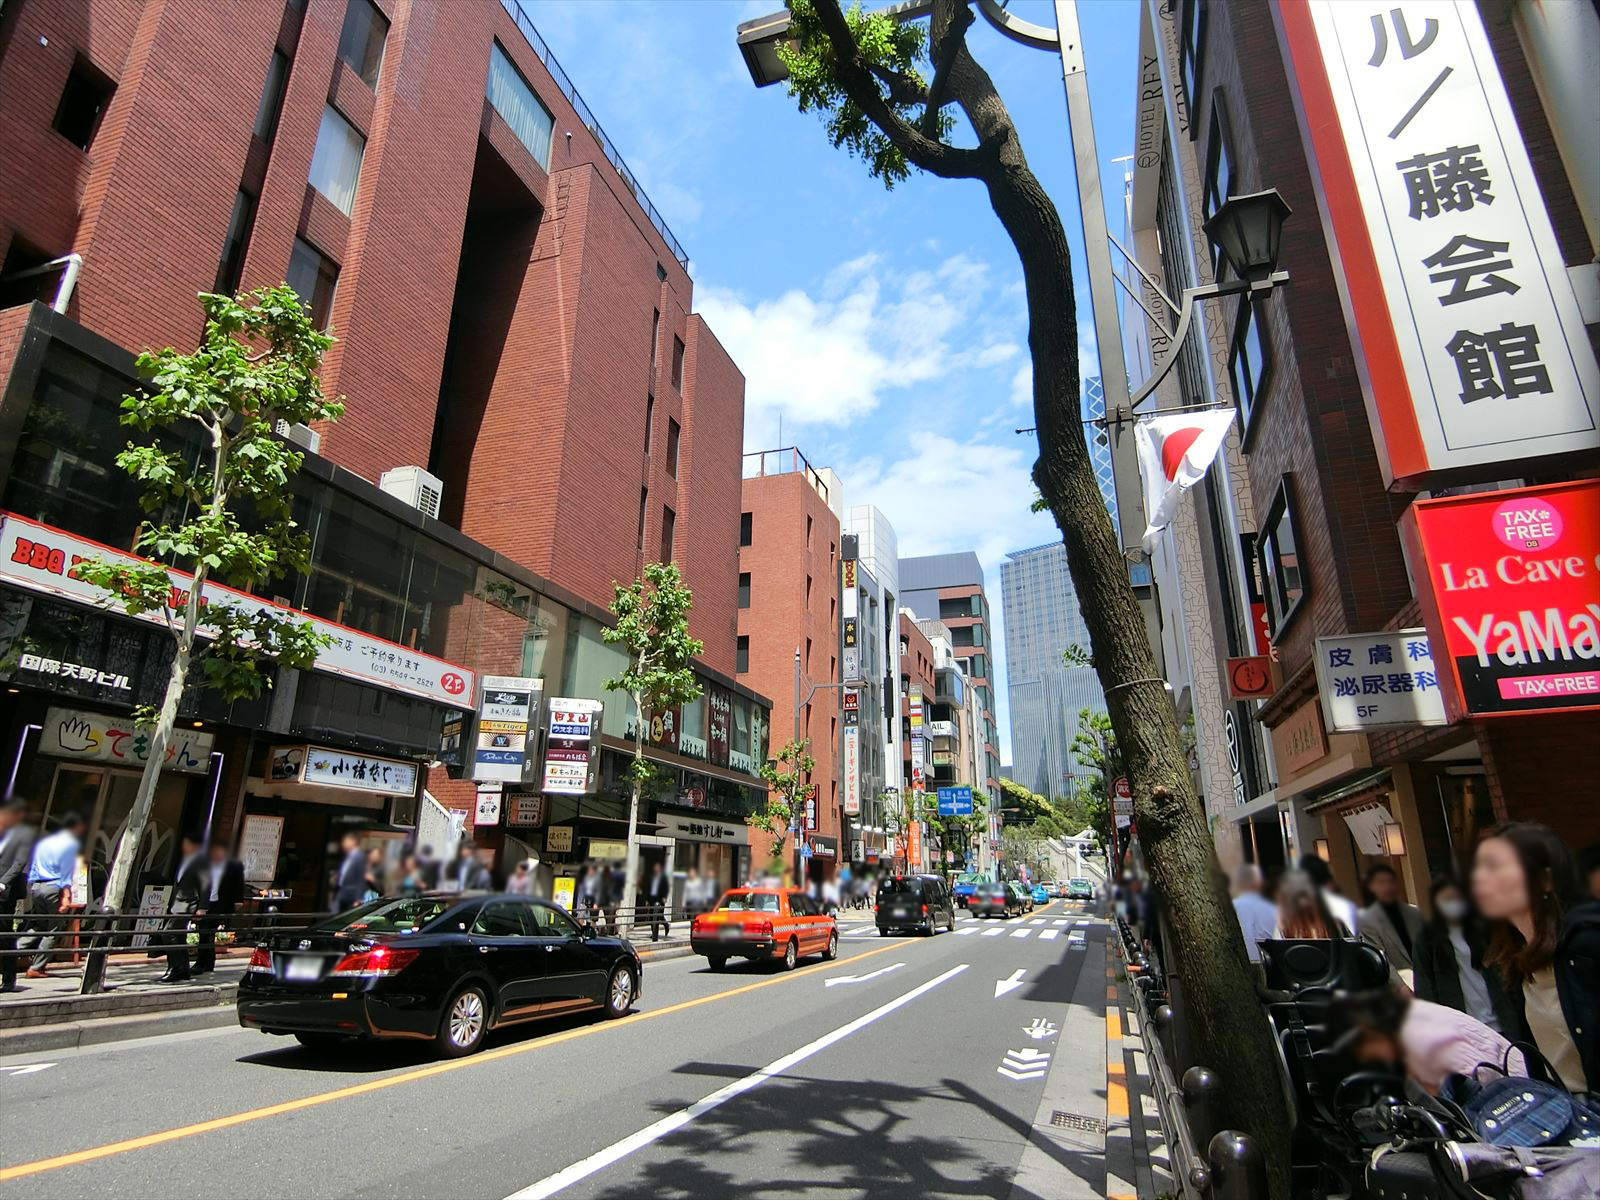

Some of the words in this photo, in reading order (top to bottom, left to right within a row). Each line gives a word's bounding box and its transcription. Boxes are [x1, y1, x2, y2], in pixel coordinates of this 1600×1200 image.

[1140, 103, 1156, 151] HOTEL
[1151, 334, 1170, 367] RE
[1500, 509, 1540, 526] TAX
[1504, 522, 1555, 541] FREE
[11, 536, 66, 575] BBQ
[1440, 562, 1489, 592] La
[1495, 555, 1585, 585] Cave
[1329, 640, 1433, 668] 皮膚科
[20, 653, 132, 691] 国際天野ビル
[444, 674, 462, 692] 2F
[1334, 669, 1441, 698] 泌尿器科
[1513, 679, 1548, 695] TAX
[1553, 676, 1599, 692] FREE
[554, 711, 589, 723] 阿里山
[1356, 705, 1379, 718] 5F
[105, 729, 199, 767] てもん
